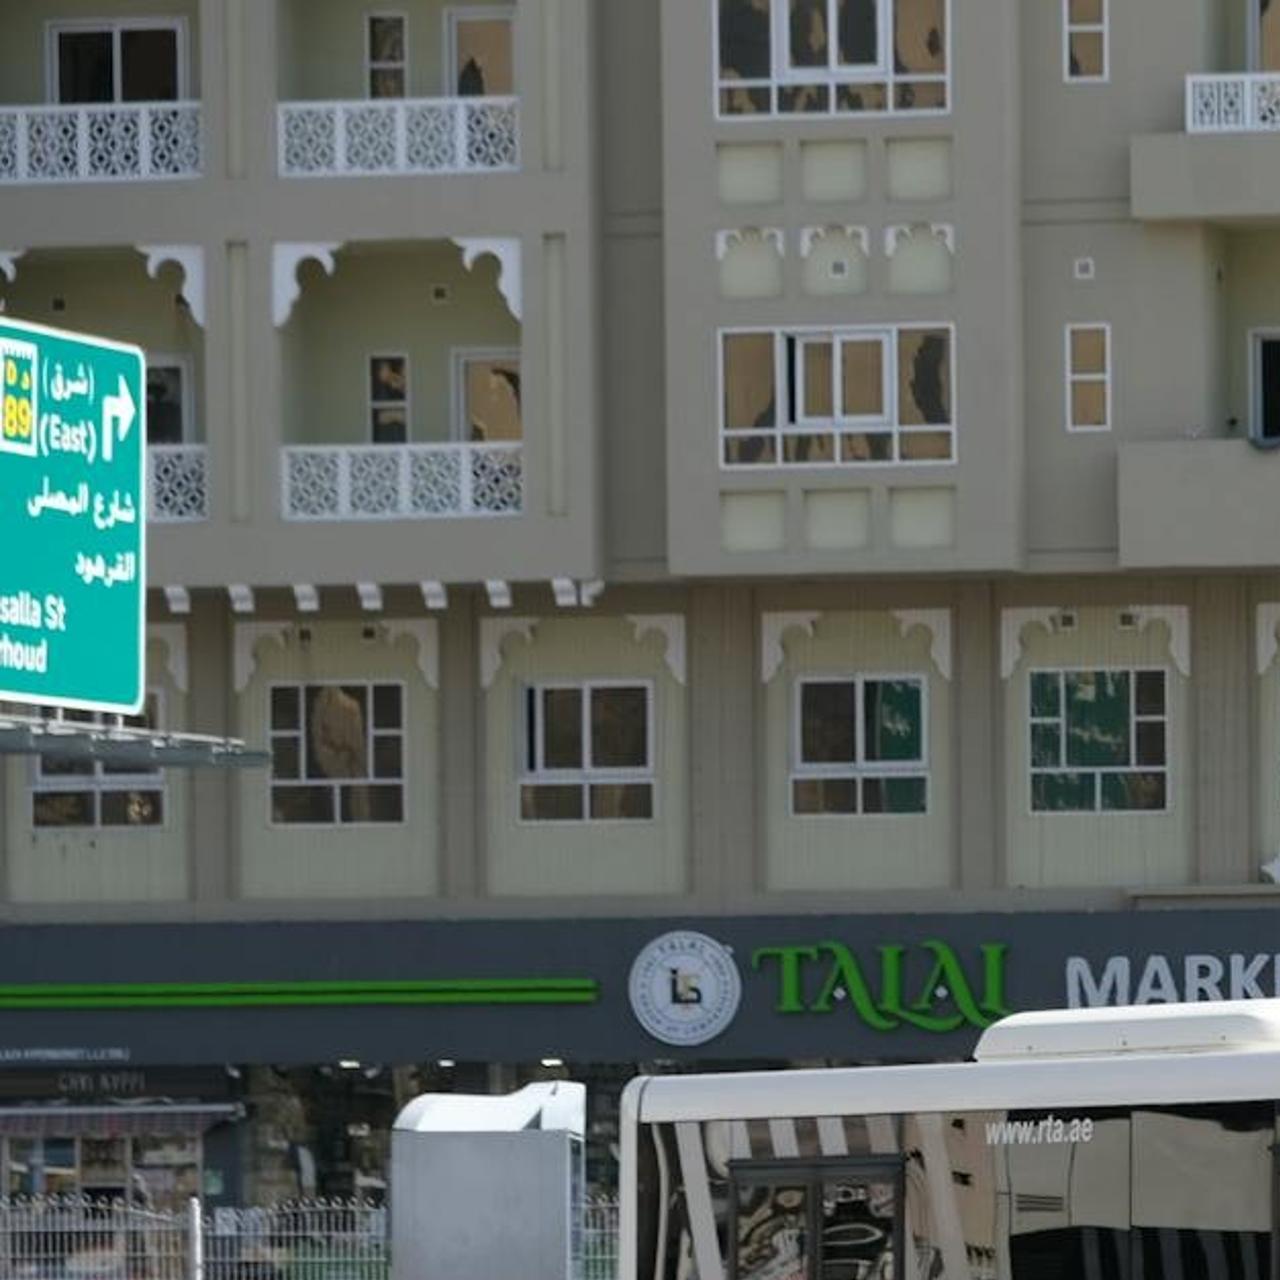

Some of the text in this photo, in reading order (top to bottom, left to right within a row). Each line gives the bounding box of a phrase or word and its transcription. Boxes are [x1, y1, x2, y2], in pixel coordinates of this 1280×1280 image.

[3, 394, 33, 438] 89
[40, 412, 97, 465] (East)
[93, 489, 136, 530] شارع
[44, 593, 66, 631] St
[985, 1114, 1094, 1144] www.rta.ae
